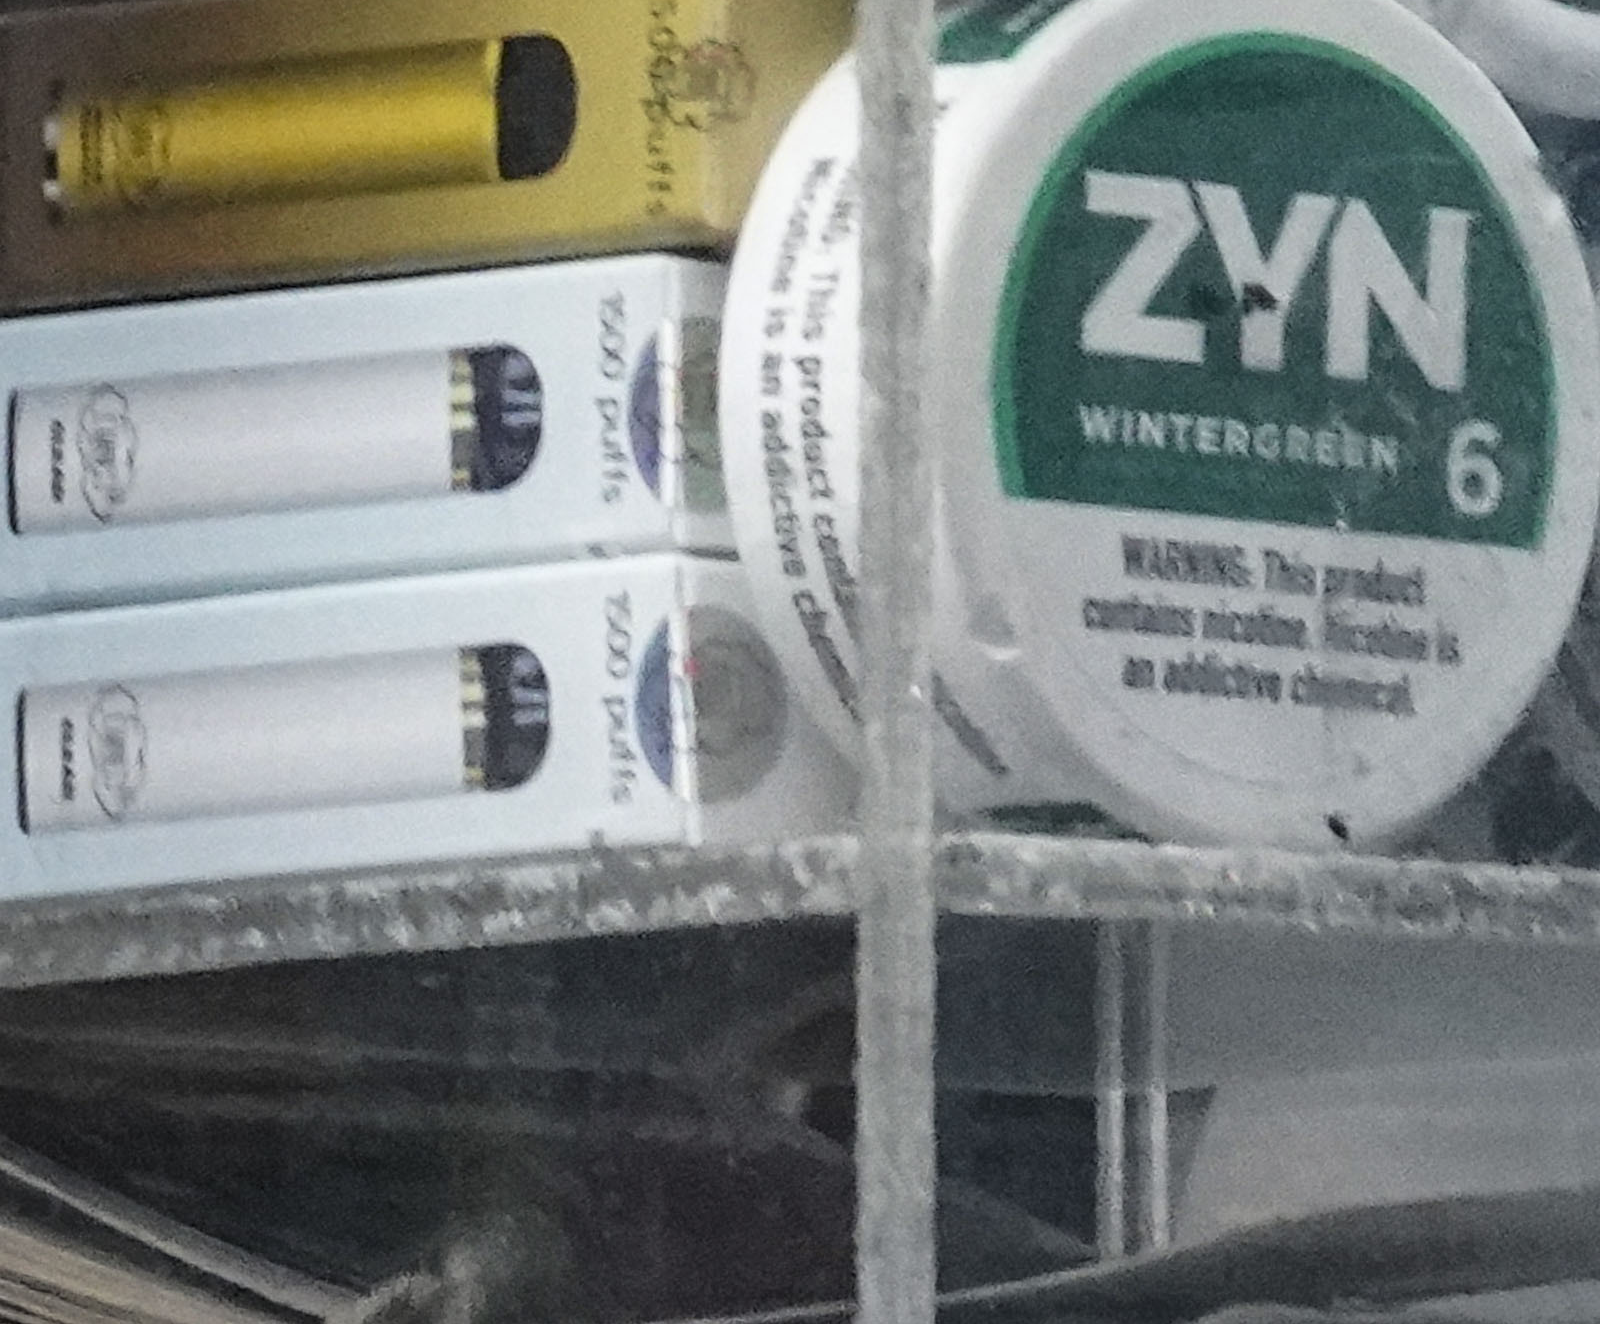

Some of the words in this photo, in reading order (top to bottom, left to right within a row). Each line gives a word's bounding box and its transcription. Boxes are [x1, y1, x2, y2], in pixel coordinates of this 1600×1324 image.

[1080, 168, 1480, 393] ZYN
[1077, 404, 1400, 477] WINTERGREEN
[1445, 418, 1503, 517] 6
